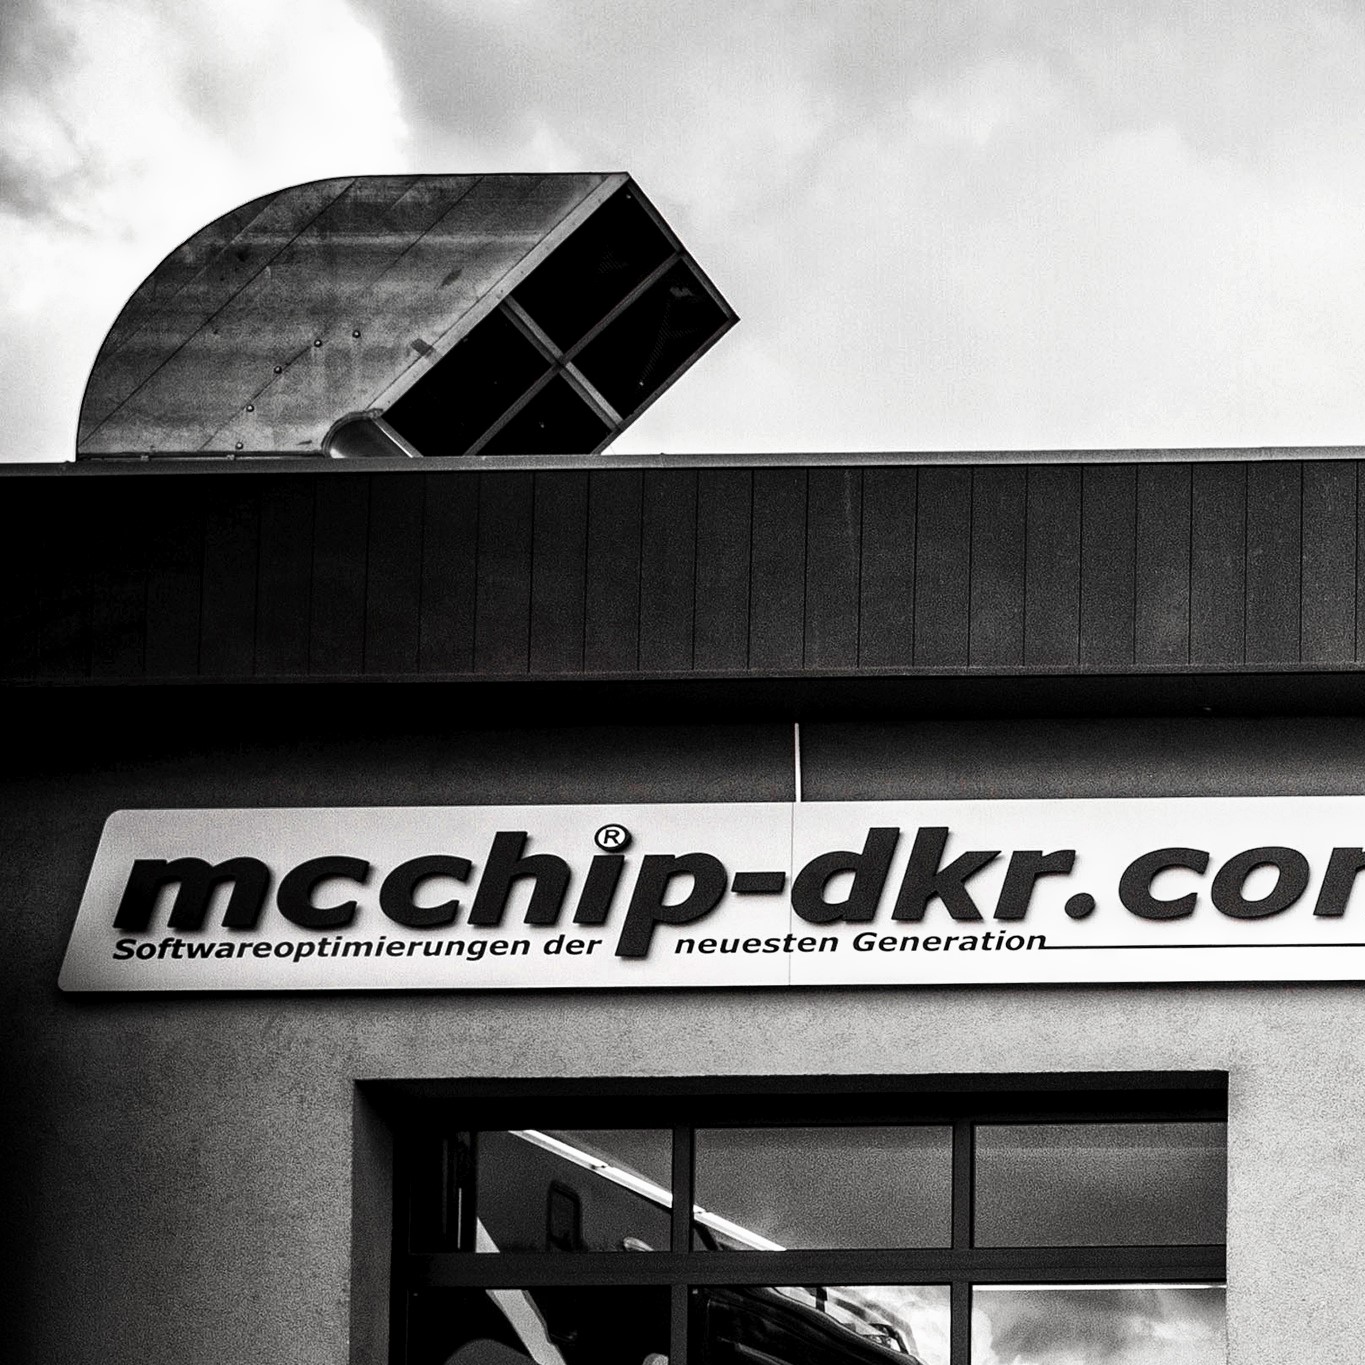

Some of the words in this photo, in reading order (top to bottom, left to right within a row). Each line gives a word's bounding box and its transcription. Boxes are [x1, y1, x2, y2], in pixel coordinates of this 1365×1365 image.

[112, 934, 530, 962] Softwareoptimierungen
[543, 933, 603, 957] der
[674, 931, 839, 954] neuesten
[852, 930, 1047, 953] Generation
